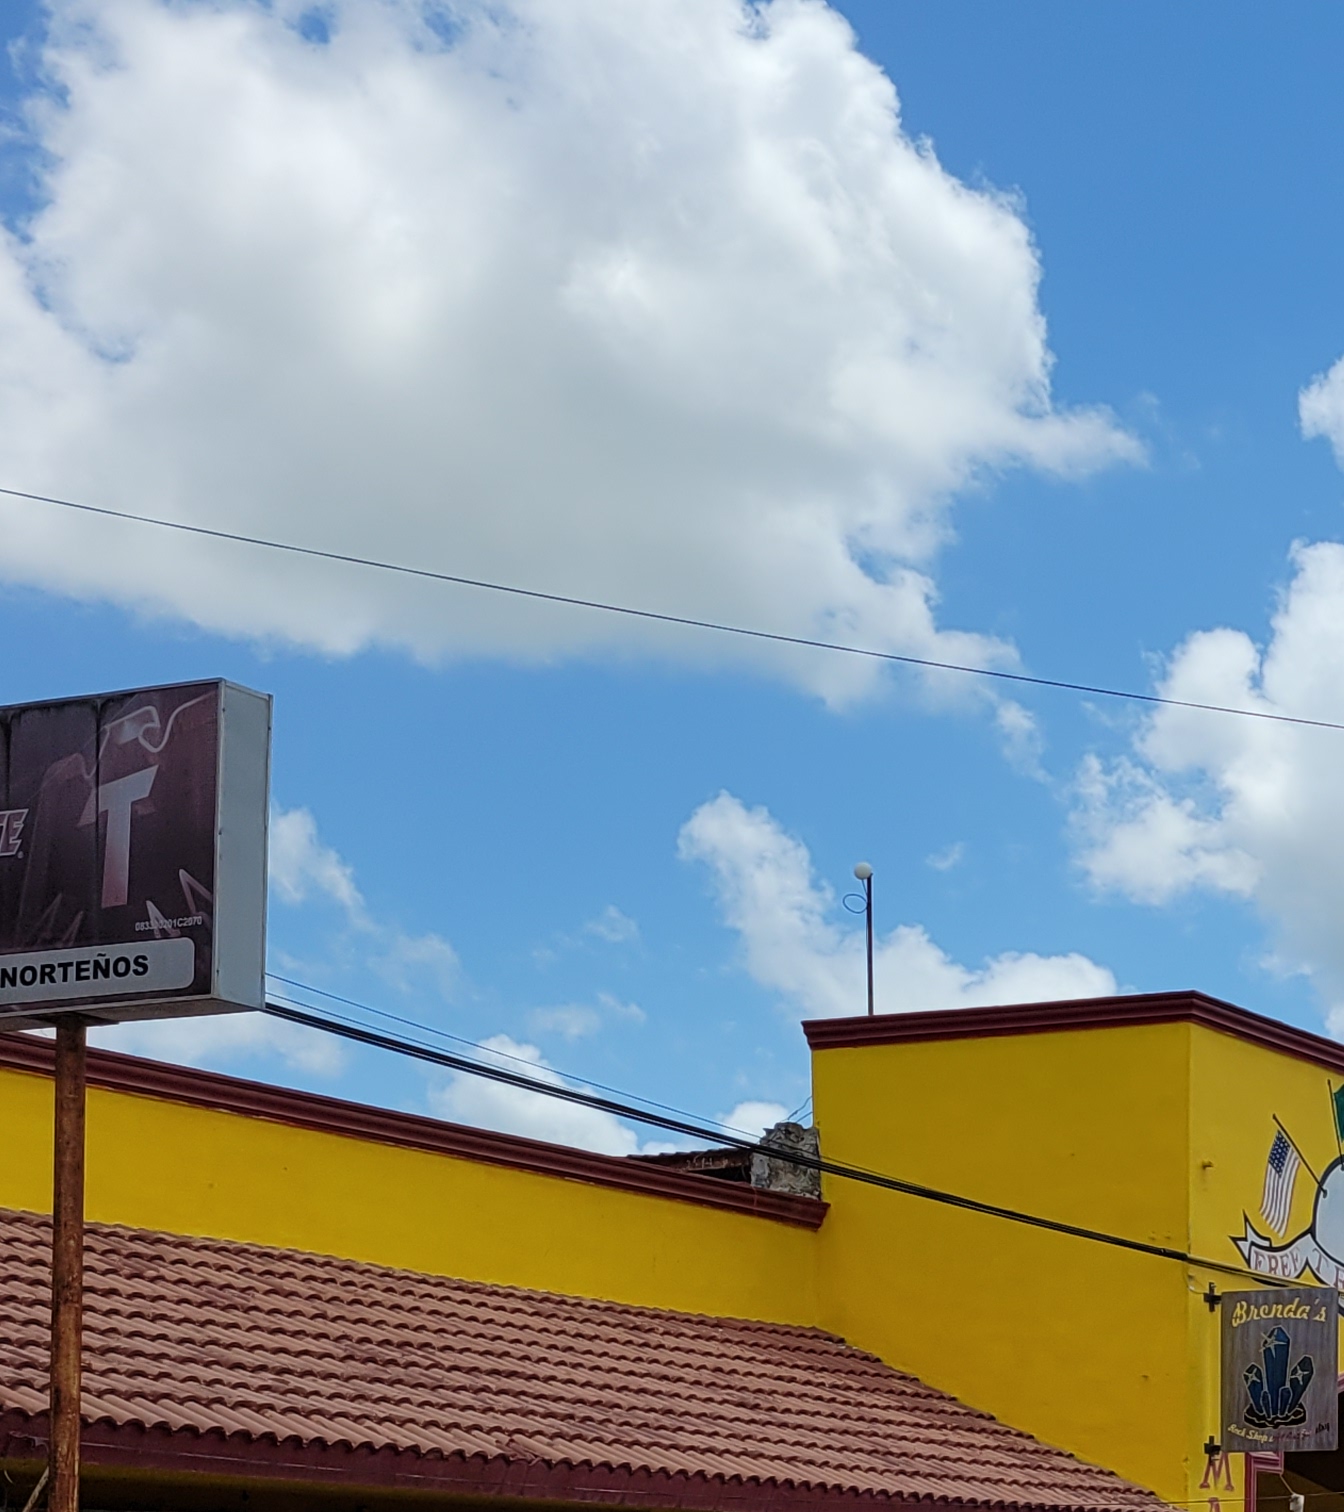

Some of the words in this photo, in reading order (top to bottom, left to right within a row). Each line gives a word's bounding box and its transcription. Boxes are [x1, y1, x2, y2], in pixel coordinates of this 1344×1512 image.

[0, 953, 149, 988] NORTEÑOS
[1231, 1298, 1327, 1328] Brenda's
[1246, 1429, 1268, 1443] Shop
